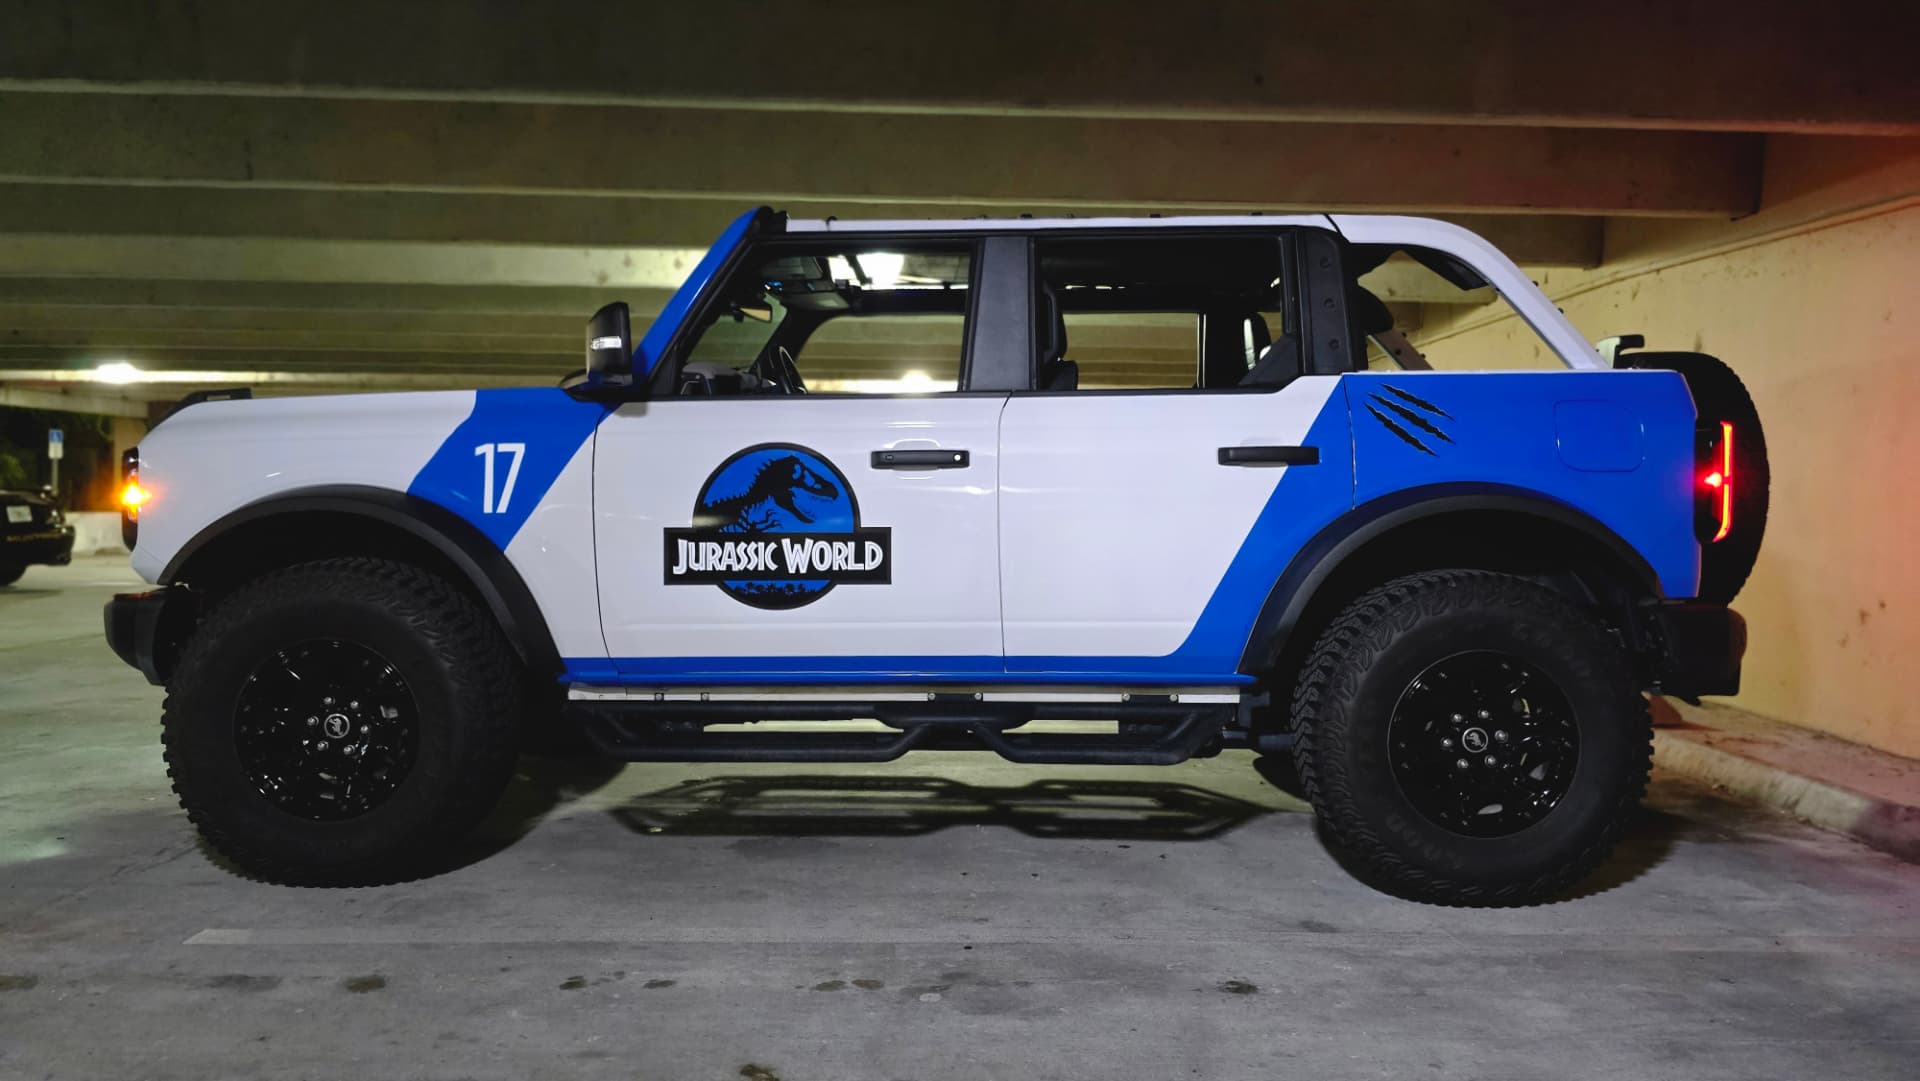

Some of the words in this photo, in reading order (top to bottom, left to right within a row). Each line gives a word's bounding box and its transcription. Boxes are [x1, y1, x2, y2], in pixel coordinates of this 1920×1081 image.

[475, 443, 525, 513] 17
[673, 538, 779, 575] JURASSIC
[781, 538, 883, 574] WORLD
